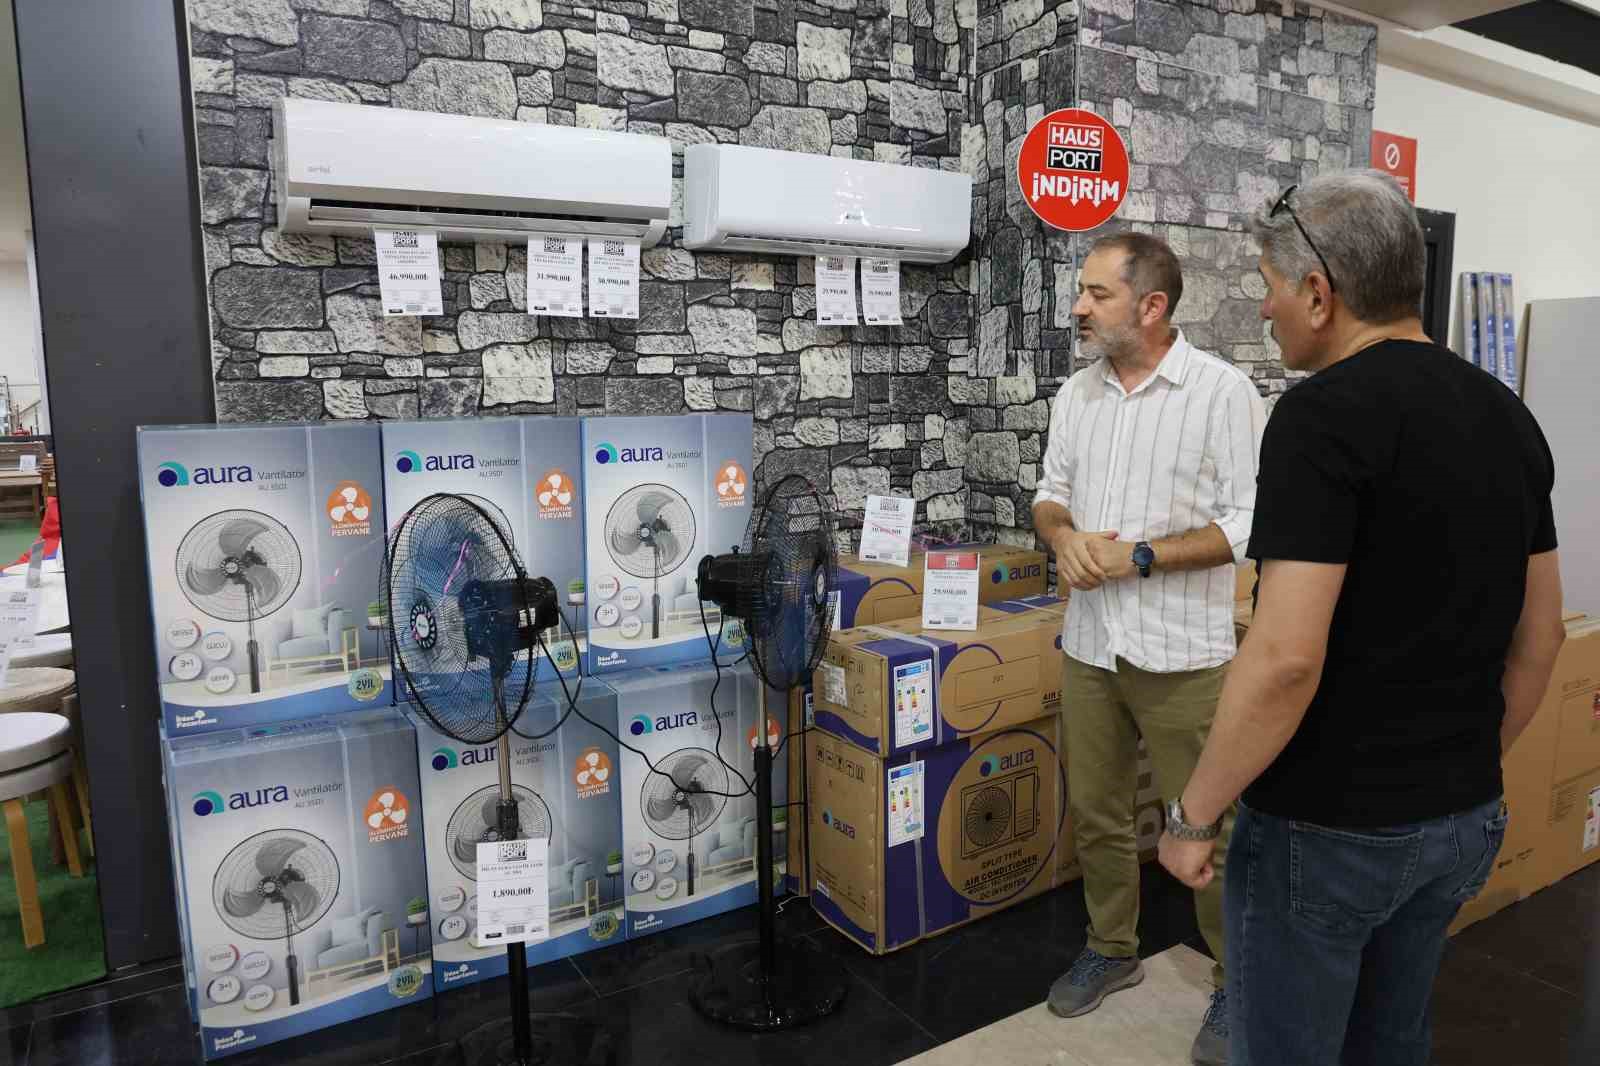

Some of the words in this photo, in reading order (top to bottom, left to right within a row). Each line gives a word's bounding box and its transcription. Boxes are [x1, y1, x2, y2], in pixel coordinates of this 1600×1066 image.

[1051, 127, 1100, 147] HAUS
[1050, 149, 1100, 170] PORT
[425, 454, 474, 472] aura
[620, 447, 663, 463] aura
[194, 465, 253, 485] aura
[539, 512, 572, 520] PERVANE
[1009, 563, 1041, 581] aura
[180, 659, 194, 668] 3+1
[655, 711, 697, 732] aura
[461, 745, 502, 767] aur
[1000, 748, 1035, 771] aura
[229, 784, 289, 810] aura
[369, 828, 410, 843] PERVANE
[832, 816, 856, 839] aura
[965, 874, 979, 888] AIR
[981, 854, 1040, 880] CONDITIONER
